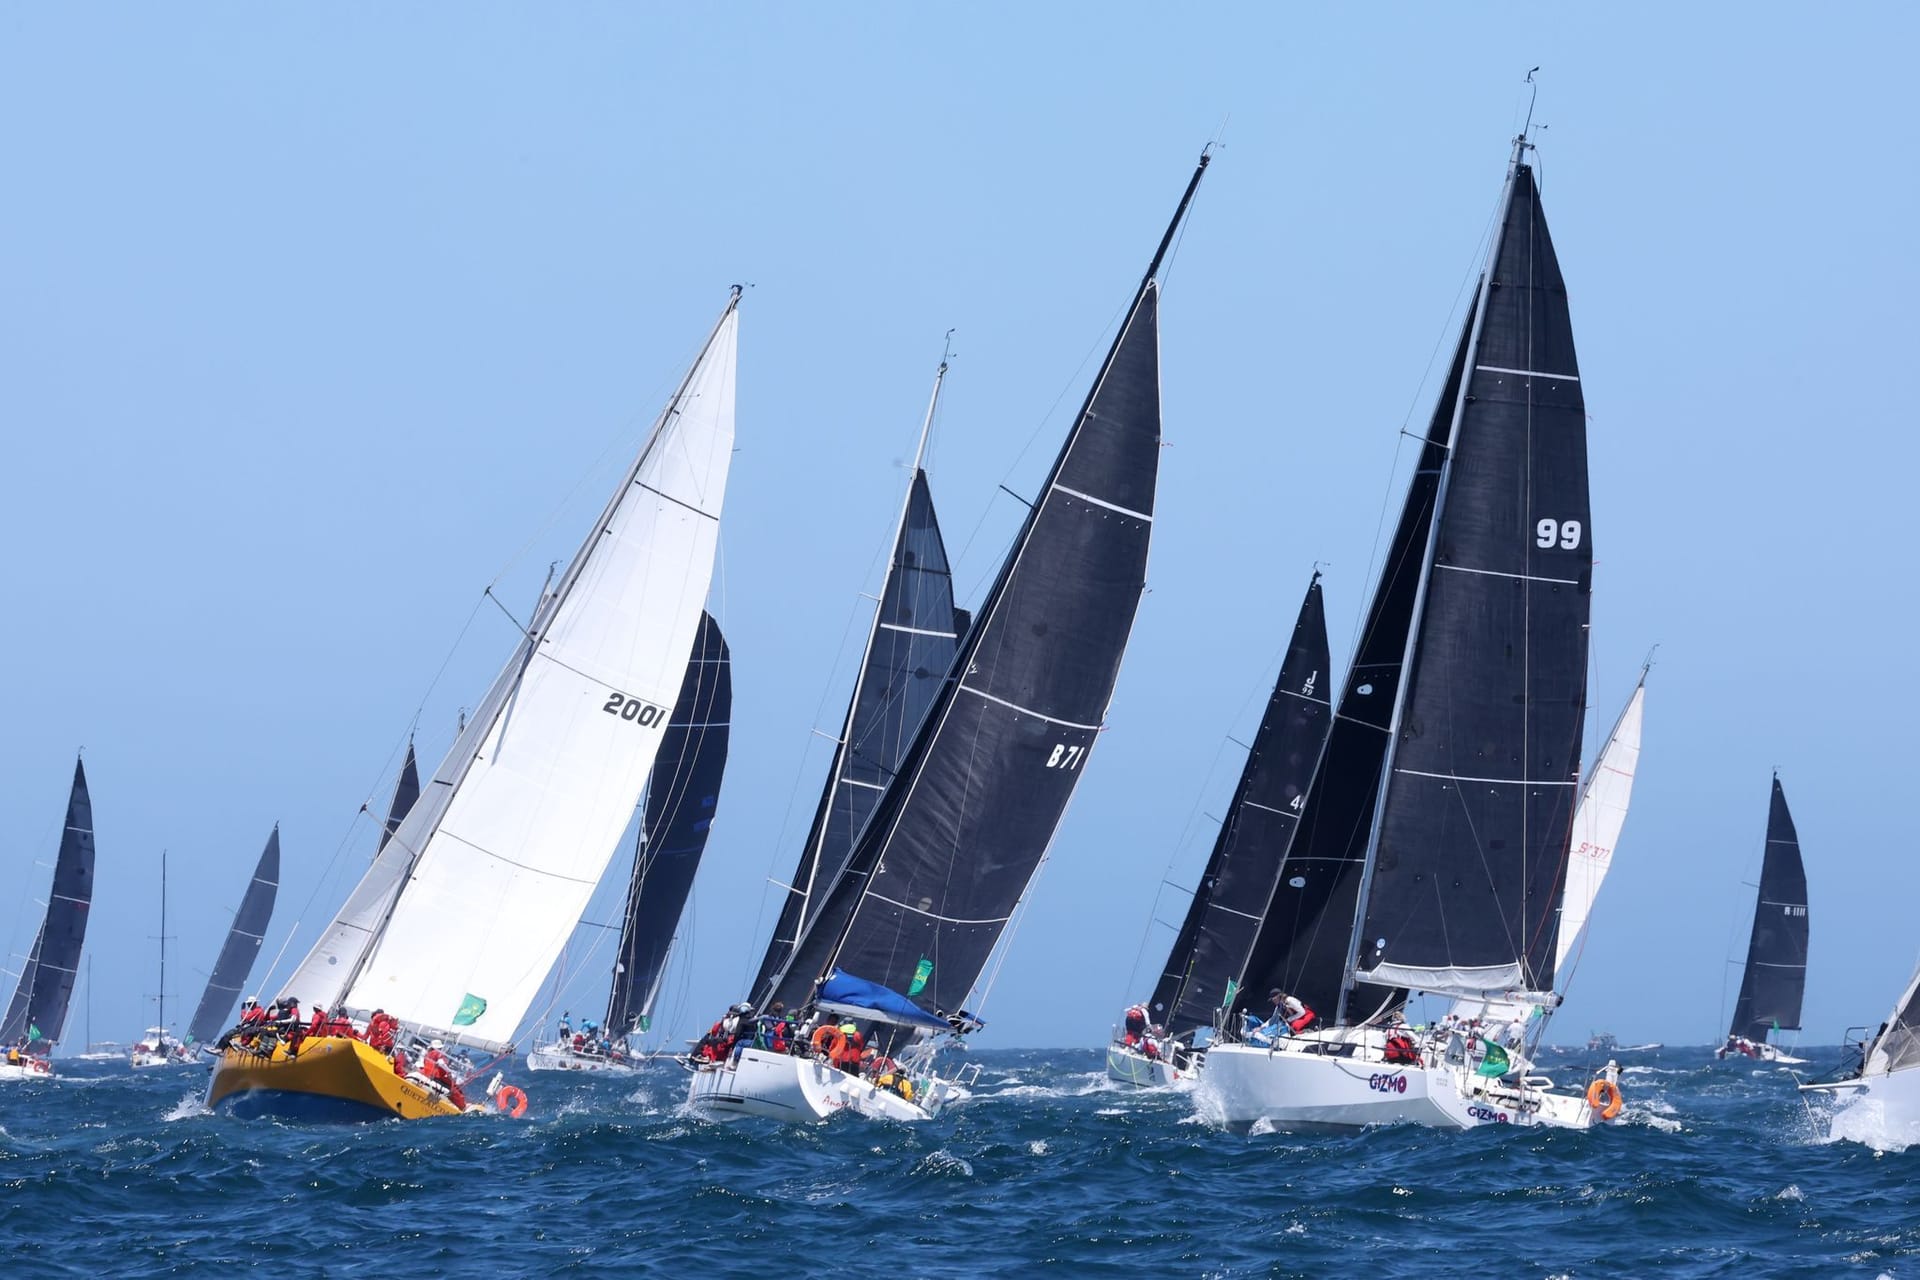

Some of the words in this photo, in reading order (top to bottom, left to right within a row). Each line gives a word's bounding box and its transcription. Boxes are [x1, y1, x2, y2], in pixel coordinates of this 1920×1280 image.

[1537, 518, 1582, 550] 99
[603, 693, 666, 729] 2001
[1369, 1073, 1407, 1094] GIZMO
[1467, 1106, 1508, 1124] GIZMO
